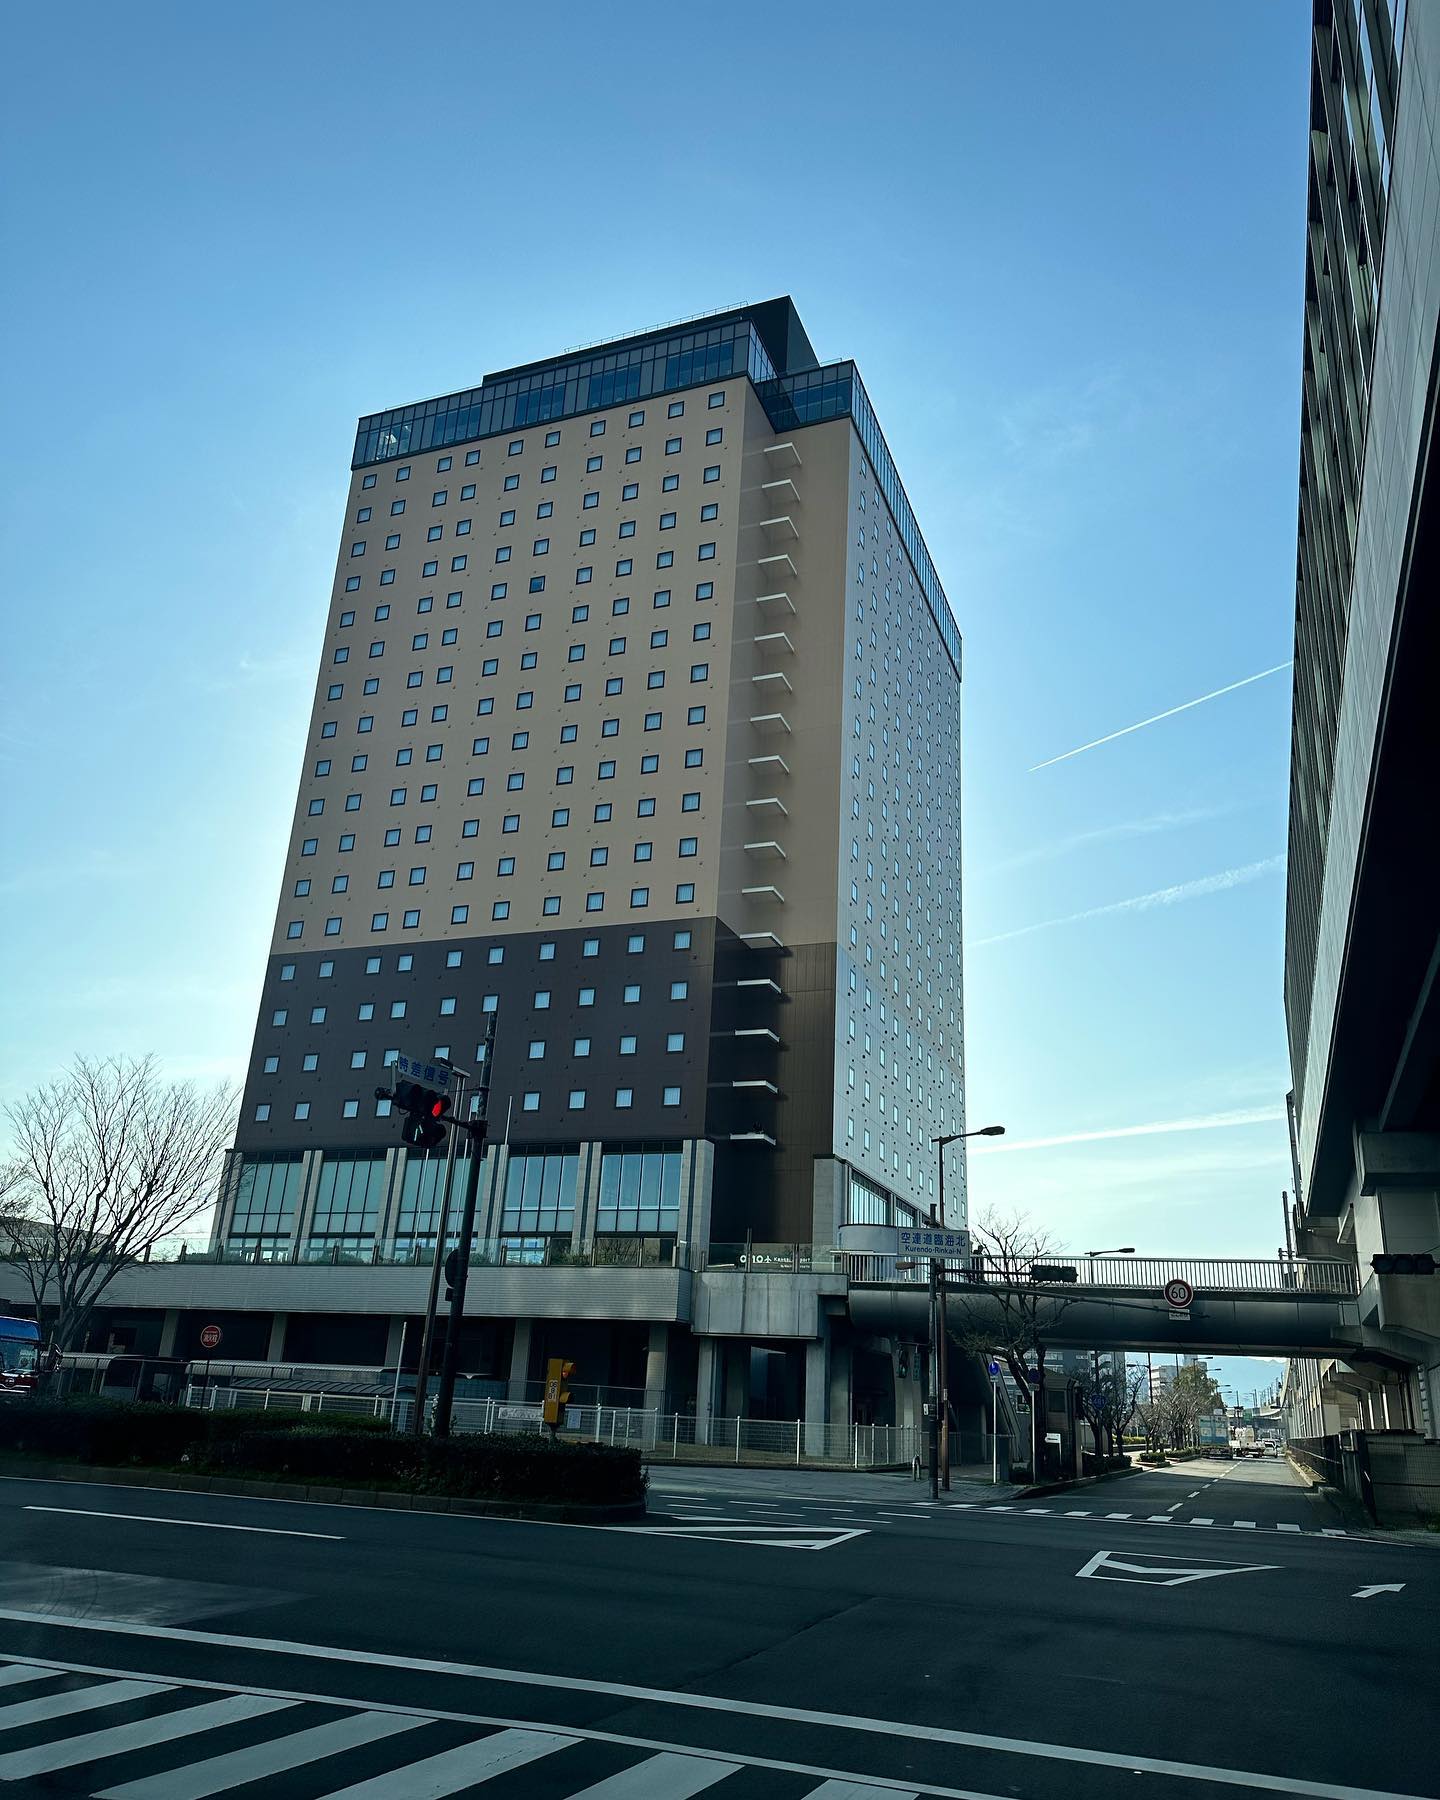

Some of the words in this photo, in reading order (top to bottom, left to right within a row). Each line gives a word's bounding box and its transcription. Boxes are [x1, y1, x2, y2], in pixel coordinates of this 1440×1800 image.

[399, 1056, 449, 1085] 時差信号
[901, 1232, 966, 1247] 空連道臨海北
[1171, 1287, 1186, 1299] 60
